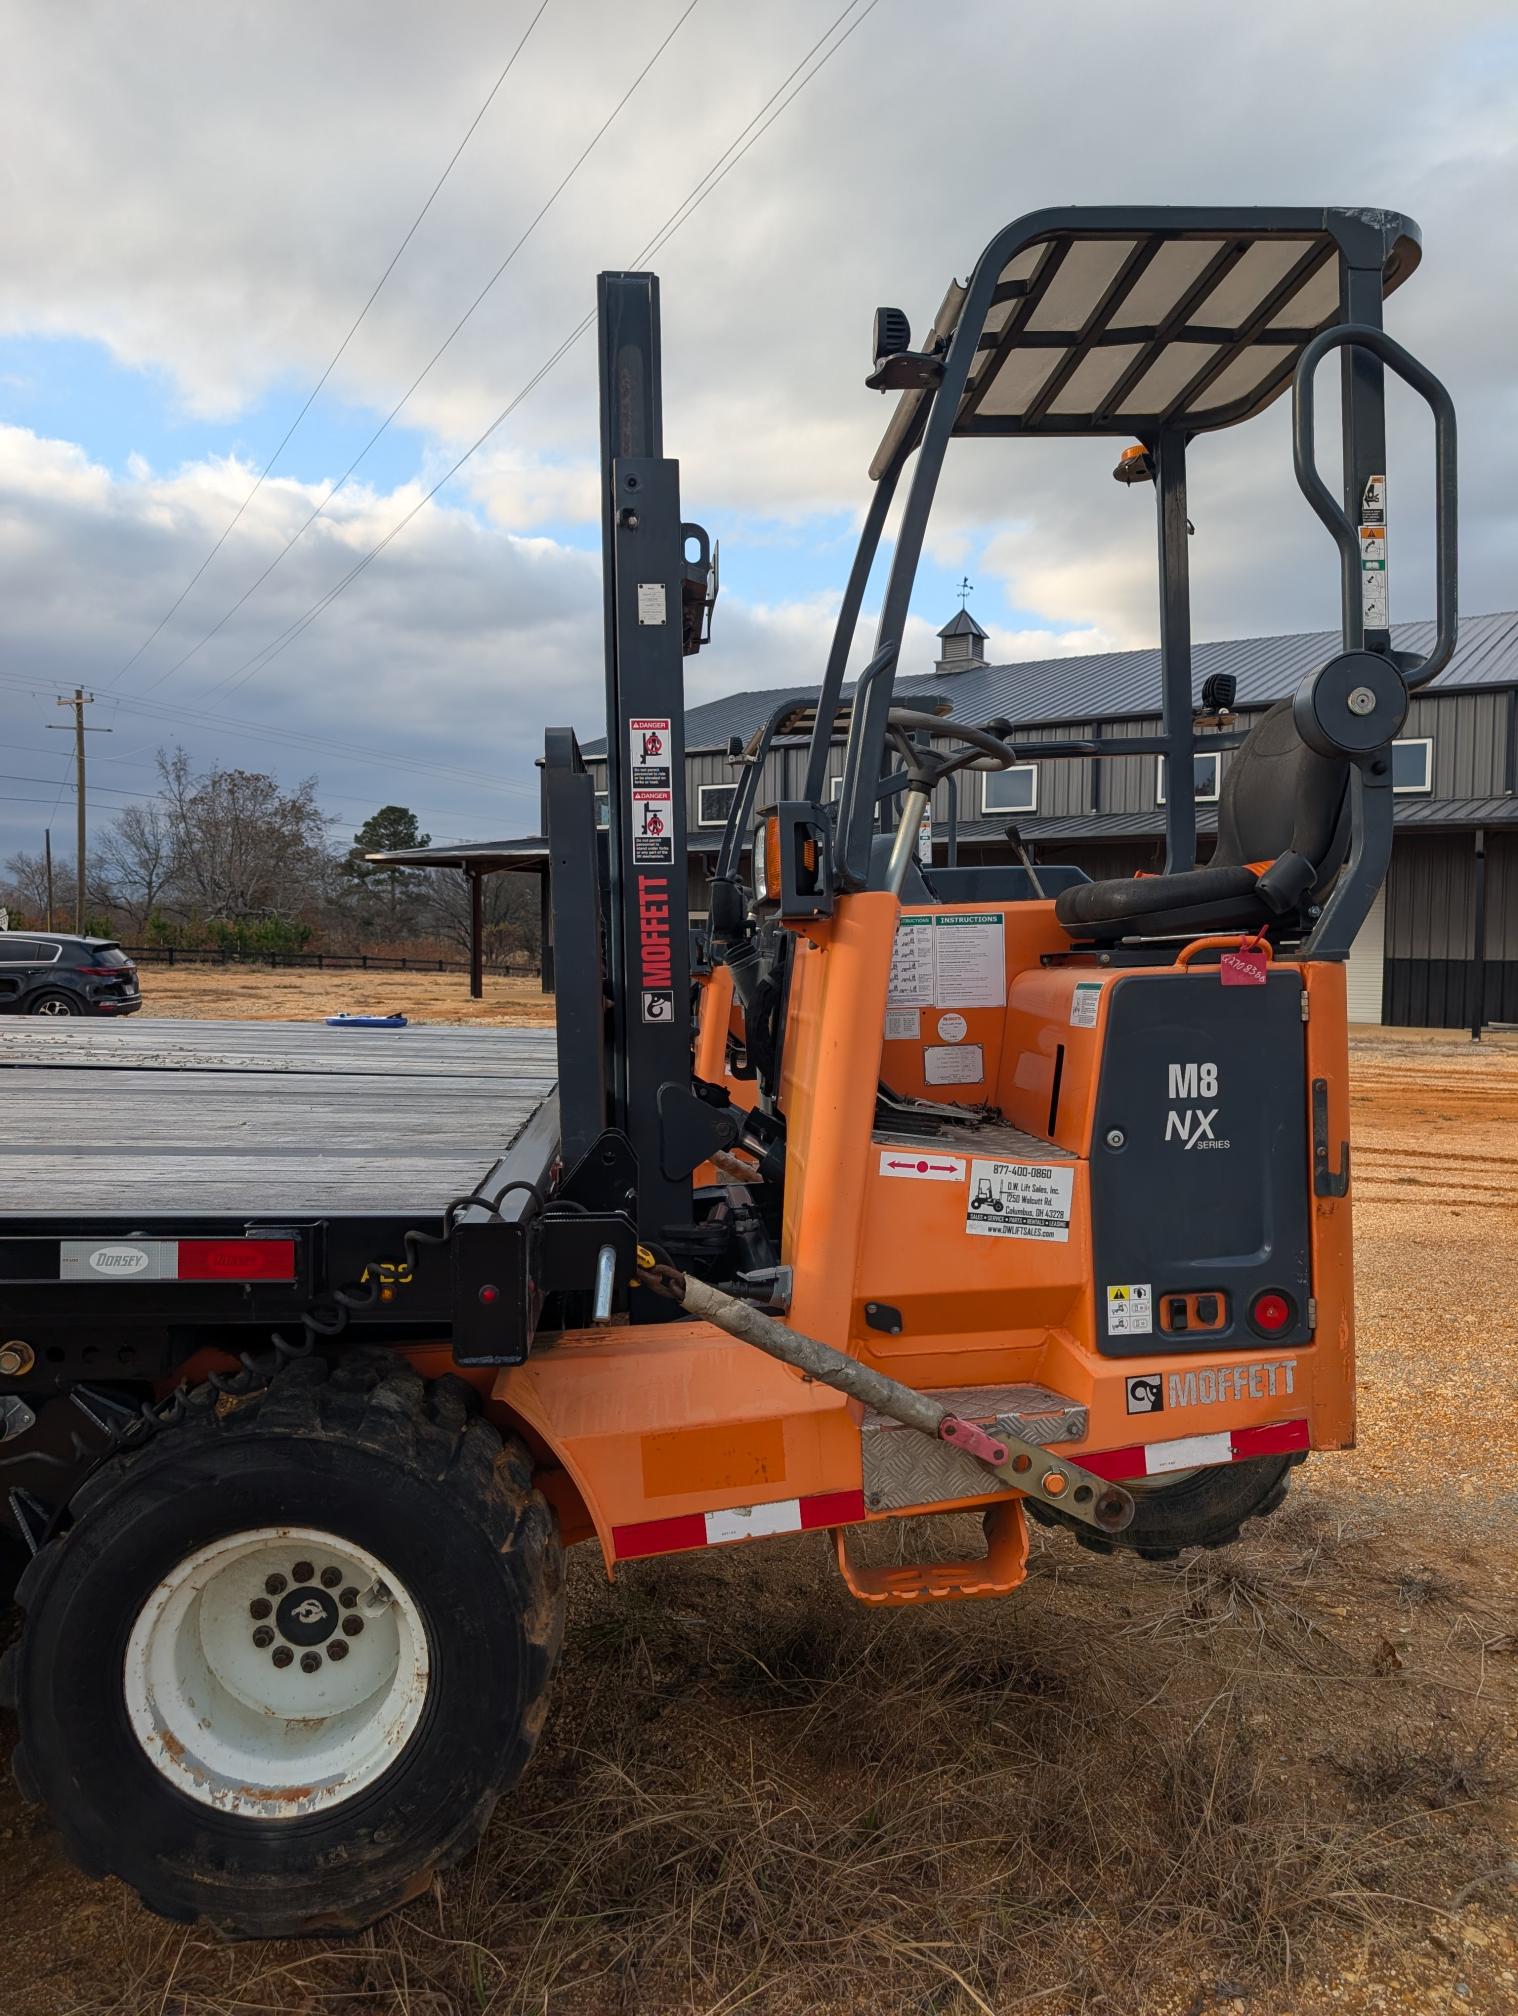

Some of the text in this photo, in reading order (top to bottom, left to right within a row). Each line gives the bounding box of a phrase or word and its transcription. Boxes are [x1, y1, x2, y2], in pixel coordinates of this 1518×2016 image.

[941, 916, 998, 924] INSTRUCTIONS
[638, 875, 671, 987] MOFFETT
[1169, 1062, 1218, 1099] M8
[1165, 1109, 1219, 1150] NX
[1197, 1140, 1231, 1150] SERIES
[993, 1164, 1052, 1179] 877-400-0860
[1021, 1183, 1031, 1192] Lift
[1032, 1184, 1049, 1195] Sales,
[1050, 1186, 1060, 1195] Inc.
[1006, 1194, 1053, 1206] 1250 Walcutt Rd.
[1005, 1205, 1065, 1219] Columbus, OH 43228
[96, 1253, 143, 1267] DORSEY
[1168, 1359, 1297, 1408] MOFFETT
